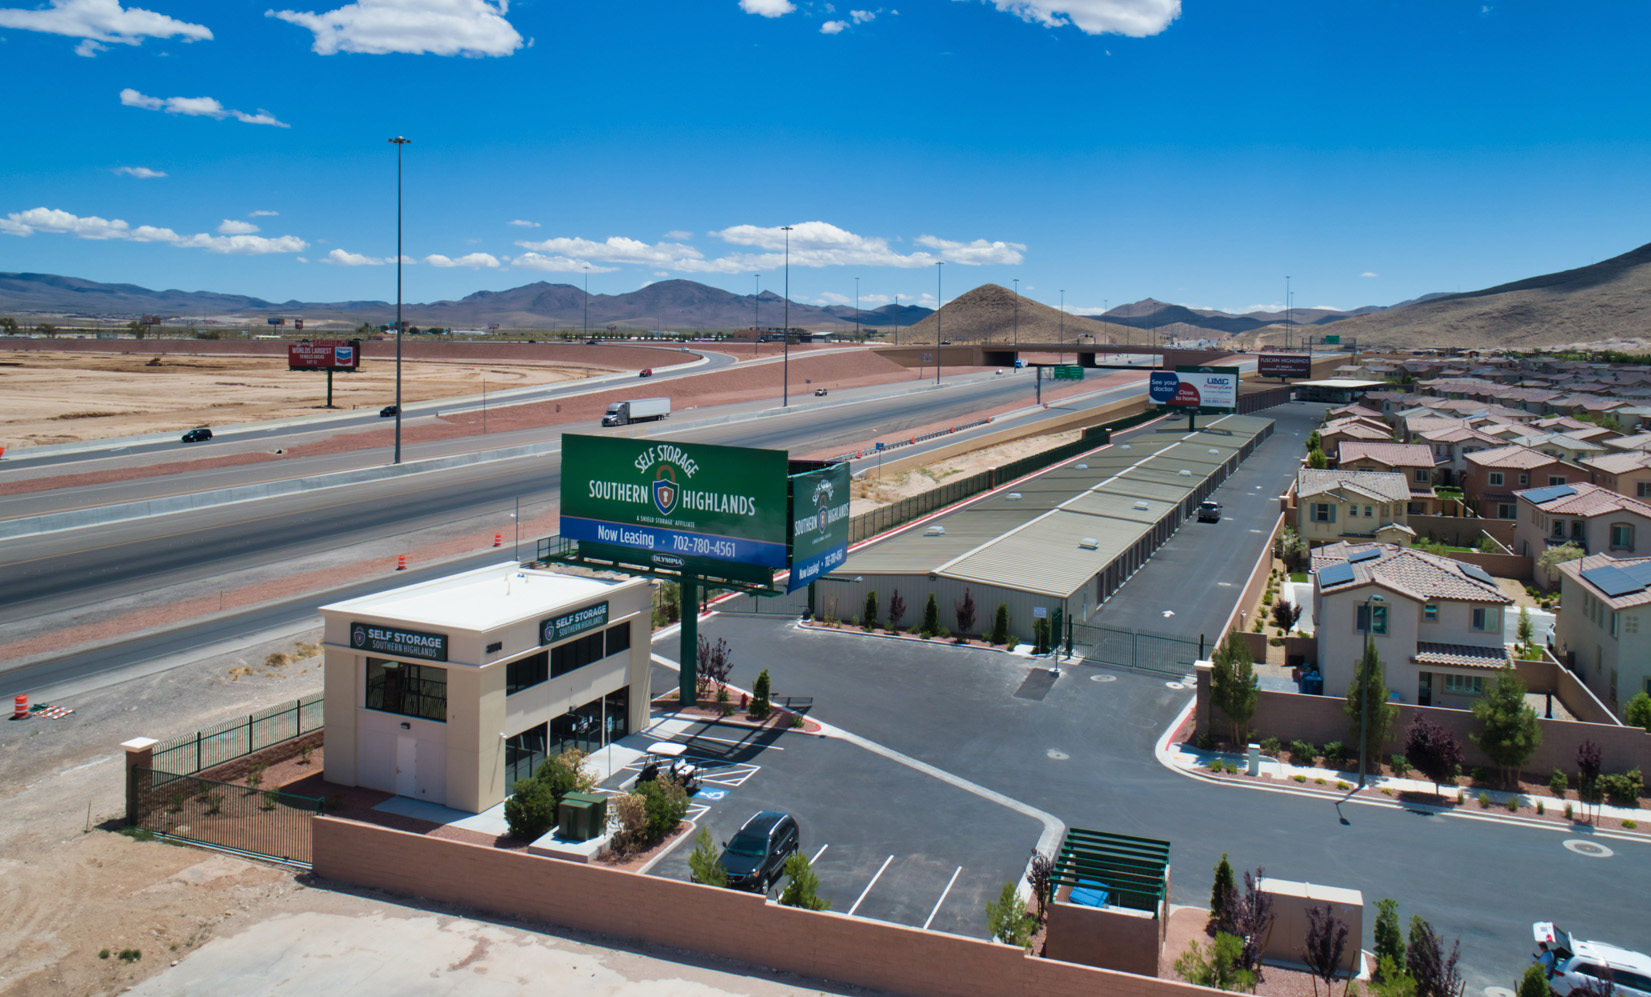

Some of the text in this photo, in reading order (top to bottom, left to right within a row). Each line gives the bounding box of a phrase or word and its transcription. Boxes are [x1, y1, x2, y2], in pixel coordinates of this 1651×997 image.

[634, 444, 699, 479] SELF STORAGE
[589, 480, 756, 516] SOUTHERN HIGHLANDS
[675, 520, 695, 528] AFFILIATE
[795, 502, 849, 536] SOUTHERN HIGHLANDS
[598, 525, 736, 558] Now Leasing 702-780-4561
[653, 555, 683, 566] OLYMPIA
[556, 604, 606, 628] SELF STORAGE
[559, 615, 603, 637] SOUTHERN HIGHLANDS
[368, 628, 441, 648] SELF STORAGE
[372, 640, 436, 657] SOUTHERN HIGHLANDS
